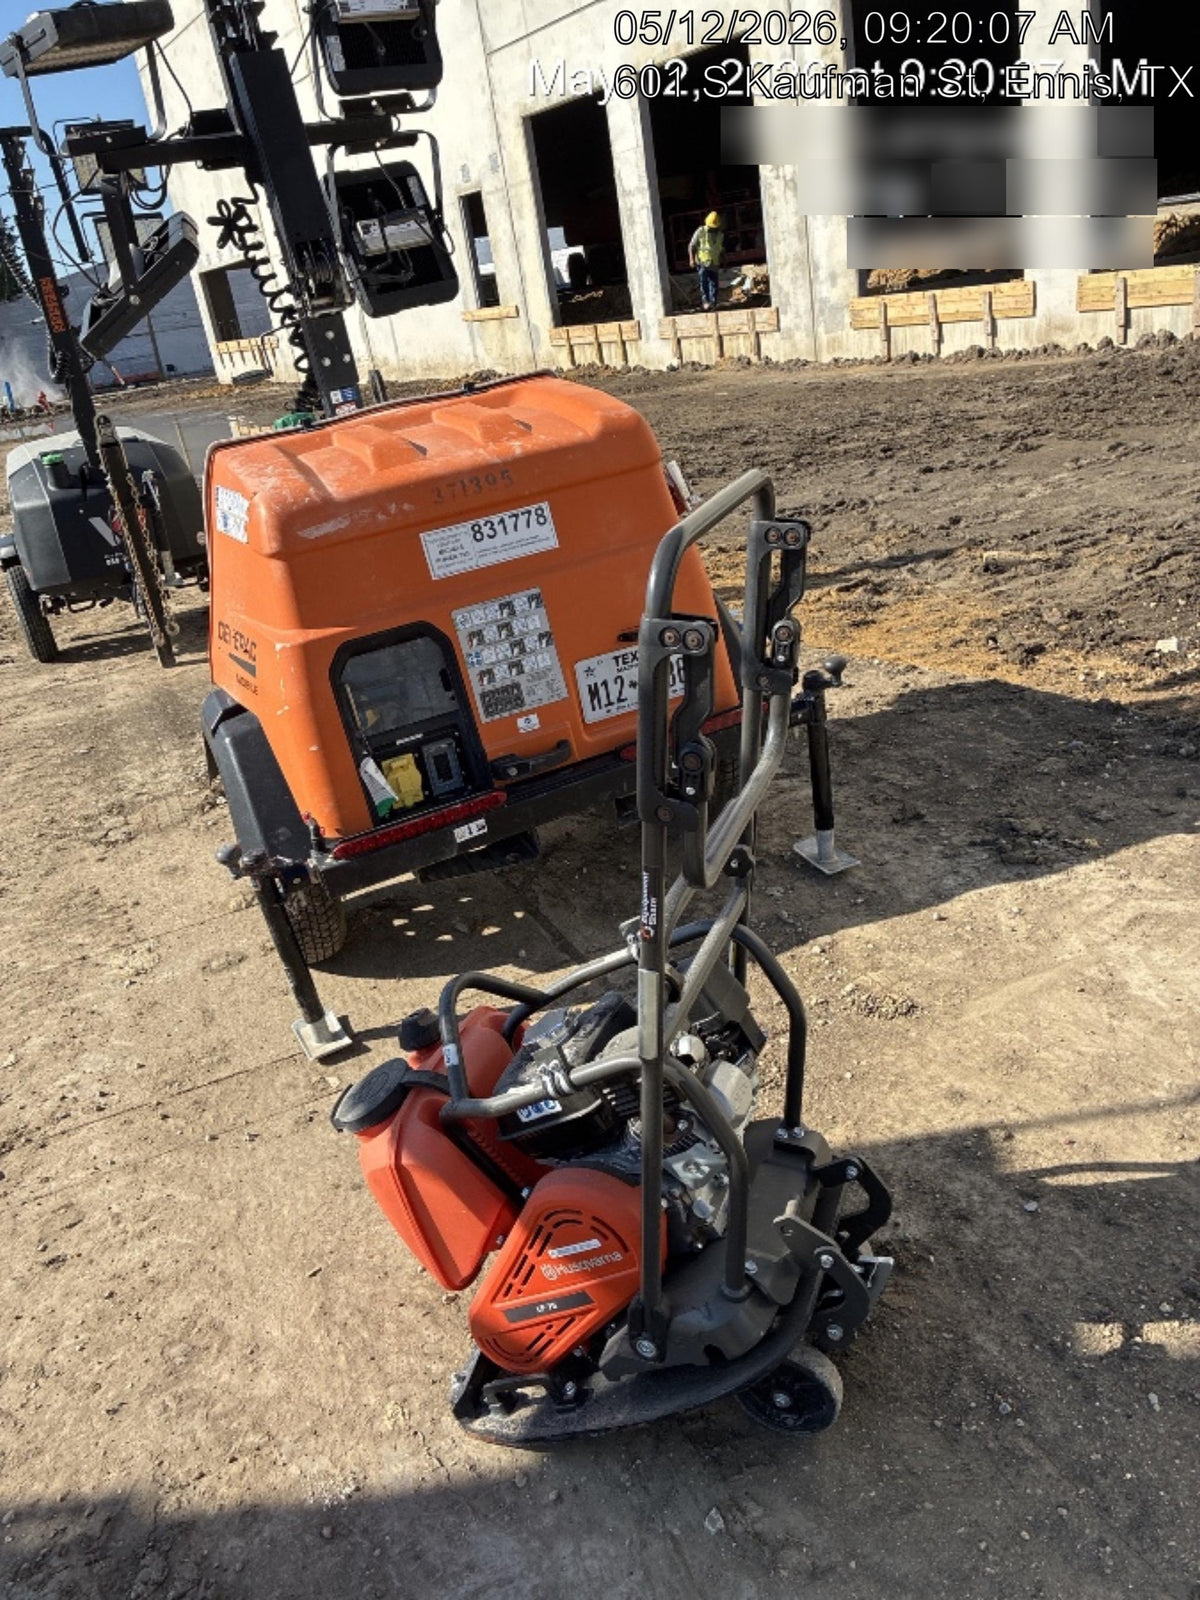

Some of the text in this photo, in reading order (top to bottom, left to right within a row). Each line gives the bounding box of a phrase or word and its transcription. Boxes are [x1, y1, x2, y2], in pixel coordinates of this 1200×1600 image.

[471, 506, 548, 543] 831778
[613, 650, 640, 669] TEX
[556, 1252, 622, 1275] Husqvarna
